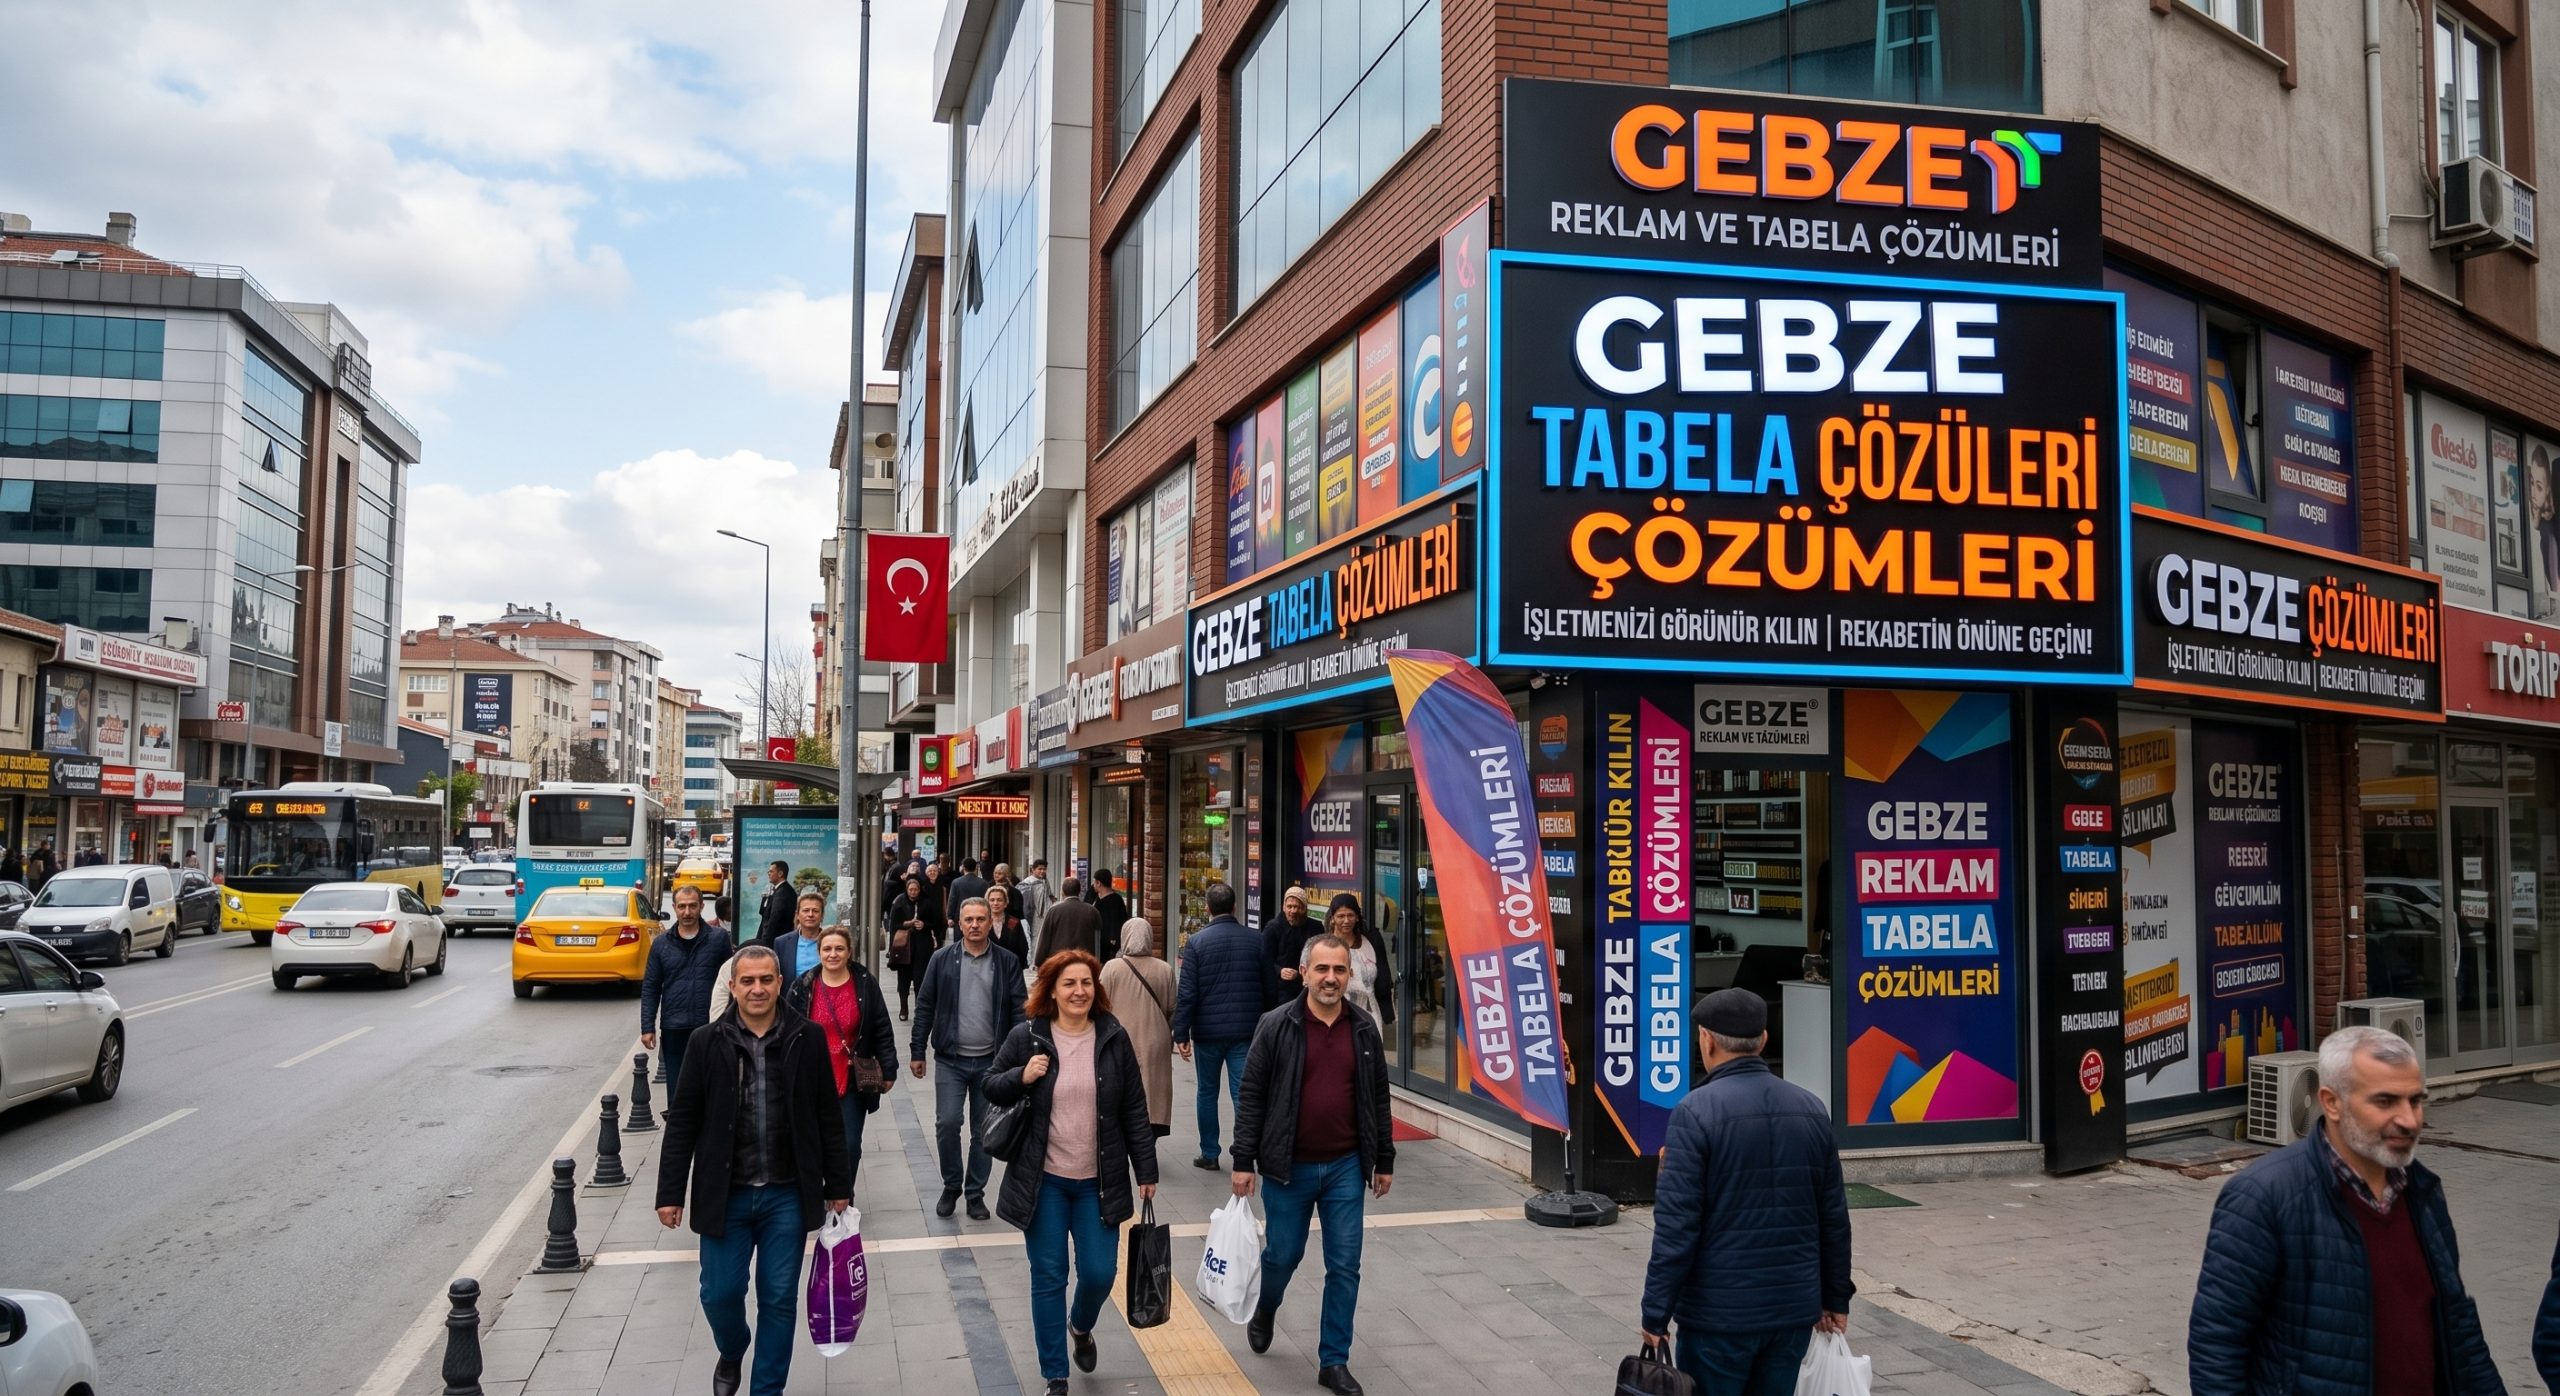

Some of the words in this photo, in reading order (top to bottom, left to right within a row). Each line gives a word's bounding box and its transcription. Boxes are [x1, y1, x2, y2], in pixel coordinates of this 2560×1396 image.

[1610, 104, 1968, 210] GEBZE
[1550, 201, 1686, 243] REKLAM
[1696, 212, 1738, 245] VE
[1747, 215, 1871, 255] TABELA
[1880, 219, 2060, 268] ÇÖZÜMLERİ
[1574, 294, 2005, 396] GEBZE
[1529, 406, 1799, 496] TABELA
[1817, 405, 2098, 515] ÇÖZÜLERİ
[1569, 497, 2095, 602] ÇÖZÜMLERİ
[1192, 595, 1262, 676] GEBZE
[1267, 570, 1333, 649] TABELA
[1337, 505, 1457, 640] ÇÖZÜMLERİ
[2157, 553, 2300, 644] GEBZE
[2307, 576, 2436, 664] ÇÖZÜMLERİ
[1523, 601, 1656, 644] İŞLETMENİZİ
[1660, 608, 1760, 645] GÖRÜNÜR
[1765, 615, 1819, 646] KILIN
[1840, 616, 1952, 651] REKABETİN
[1957, 620, 2025, 653] ÖNÜNE
[2029, 621, 2093, 658] GEÇİN!
[2167, 637, 2236, 675] İŞLETMENİZİ
[2237, 650, 2285, 683] GÖRÜNÜR
[2287, 660, 2311, 686] KILIN
[2320, 663, 2367, 694] REKABETİN
[2370, 669, 2398, 698] ÖNÜNE
[2399, 671, 2425, 705] GEÇİN!
[1700, 698, 1808, 727] GEBZE
[1700, 731, 1739, 743] REKLAM
[1742, 732, 1754, 743] VE
[1608, 713, 1633, 790] KILIN
[2208, 762, 2278, 799] GEBZE
[1310, 801, 1351, 832] GEBZE
[1469, 744, 1542, 938] ÇÖZÜMLERİ
[1647, 737, 1685, 914] ÇÖZÜMLERİ
[1867, 801, 1988, 840] GEBZE
[1543, 855, 1574, 873] ABELA
[1861, 857, 1994, 894] REKLAM
[2065, 851, 2111, 868] TABELA
[1866, 914, 1994, 951] TABELA
[1466, 953, 1515, 1083] GEBZE
[1512, 946, 1558, 1083] TABELA
[1603, 938, 1634, 1086] GEBZE
[1650, 932, 1681, 1093] GEBELA
[1859, 963, 1999, 1004] ÇÖZÜMLERİ
